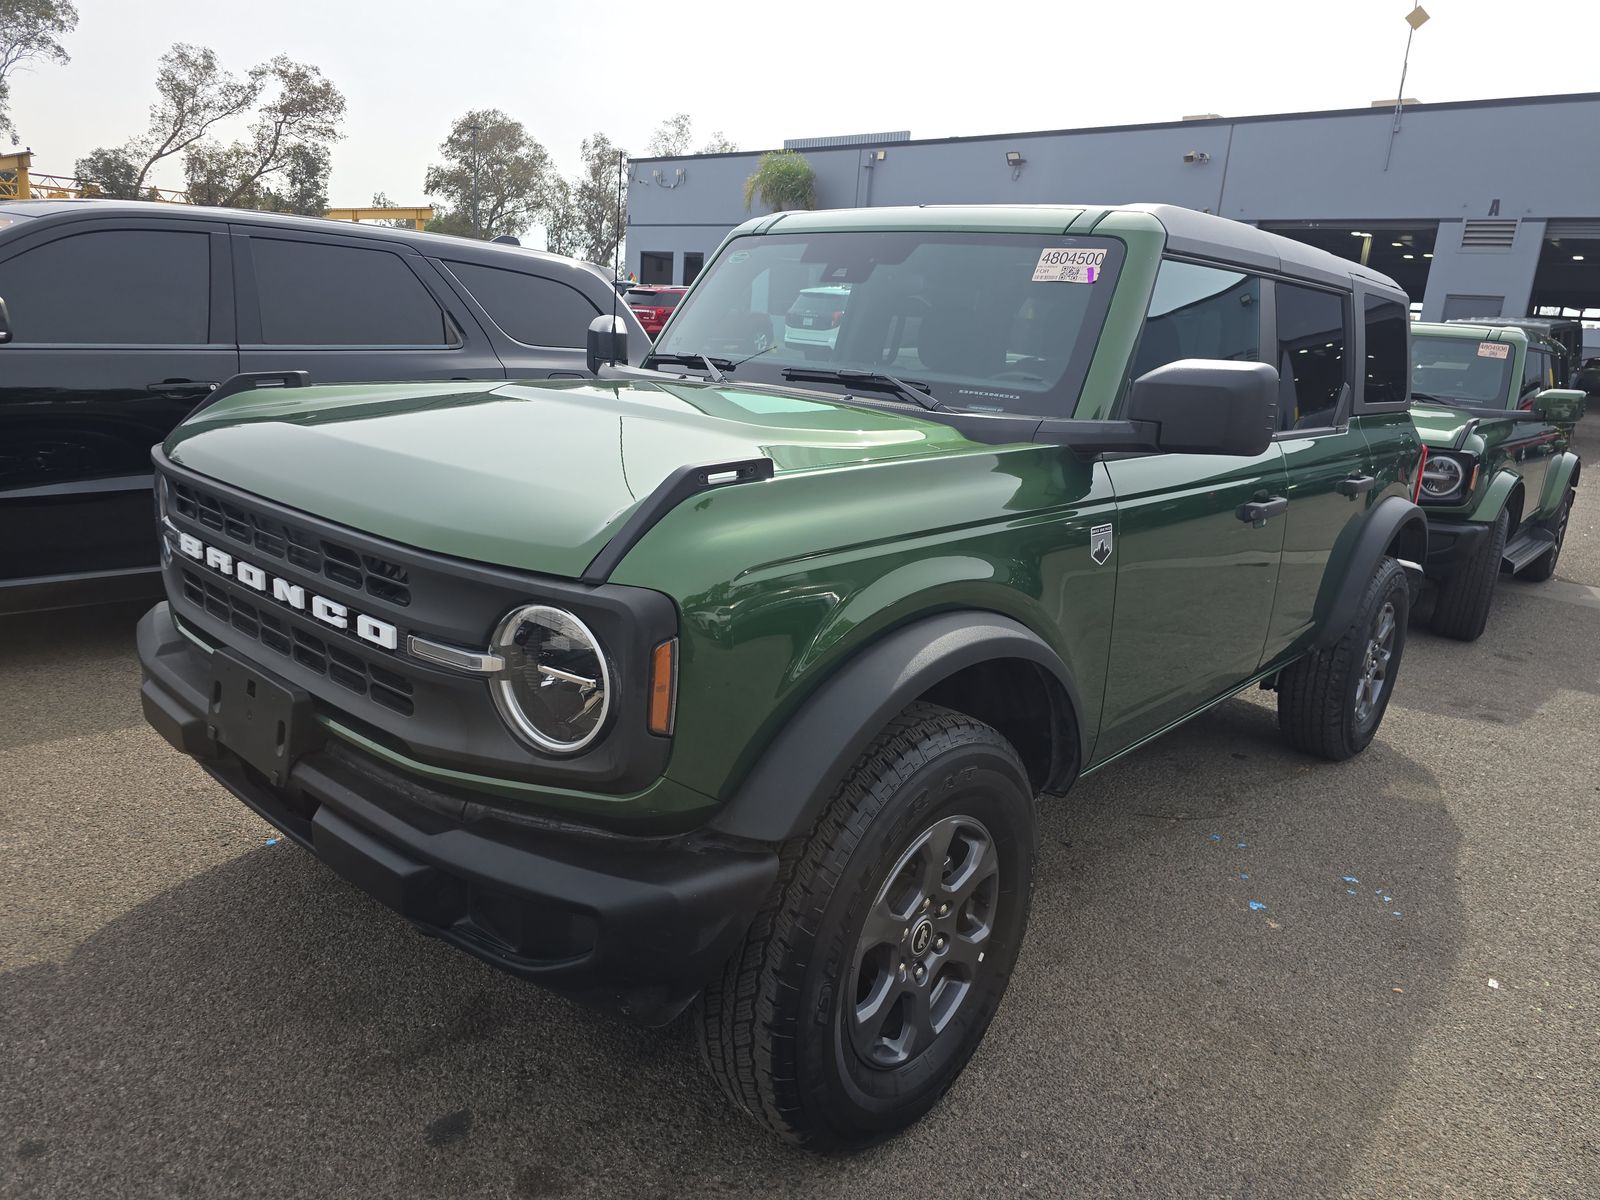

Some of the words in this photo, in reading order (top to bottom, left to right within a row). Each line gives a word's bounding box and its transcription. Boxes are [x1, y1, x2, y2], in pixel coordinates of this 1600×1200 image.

[1488, 199, 1500, 216] A
[1042, 251, 1105, 266] 4804500
[180, 532, 398, 650] BRONCO
